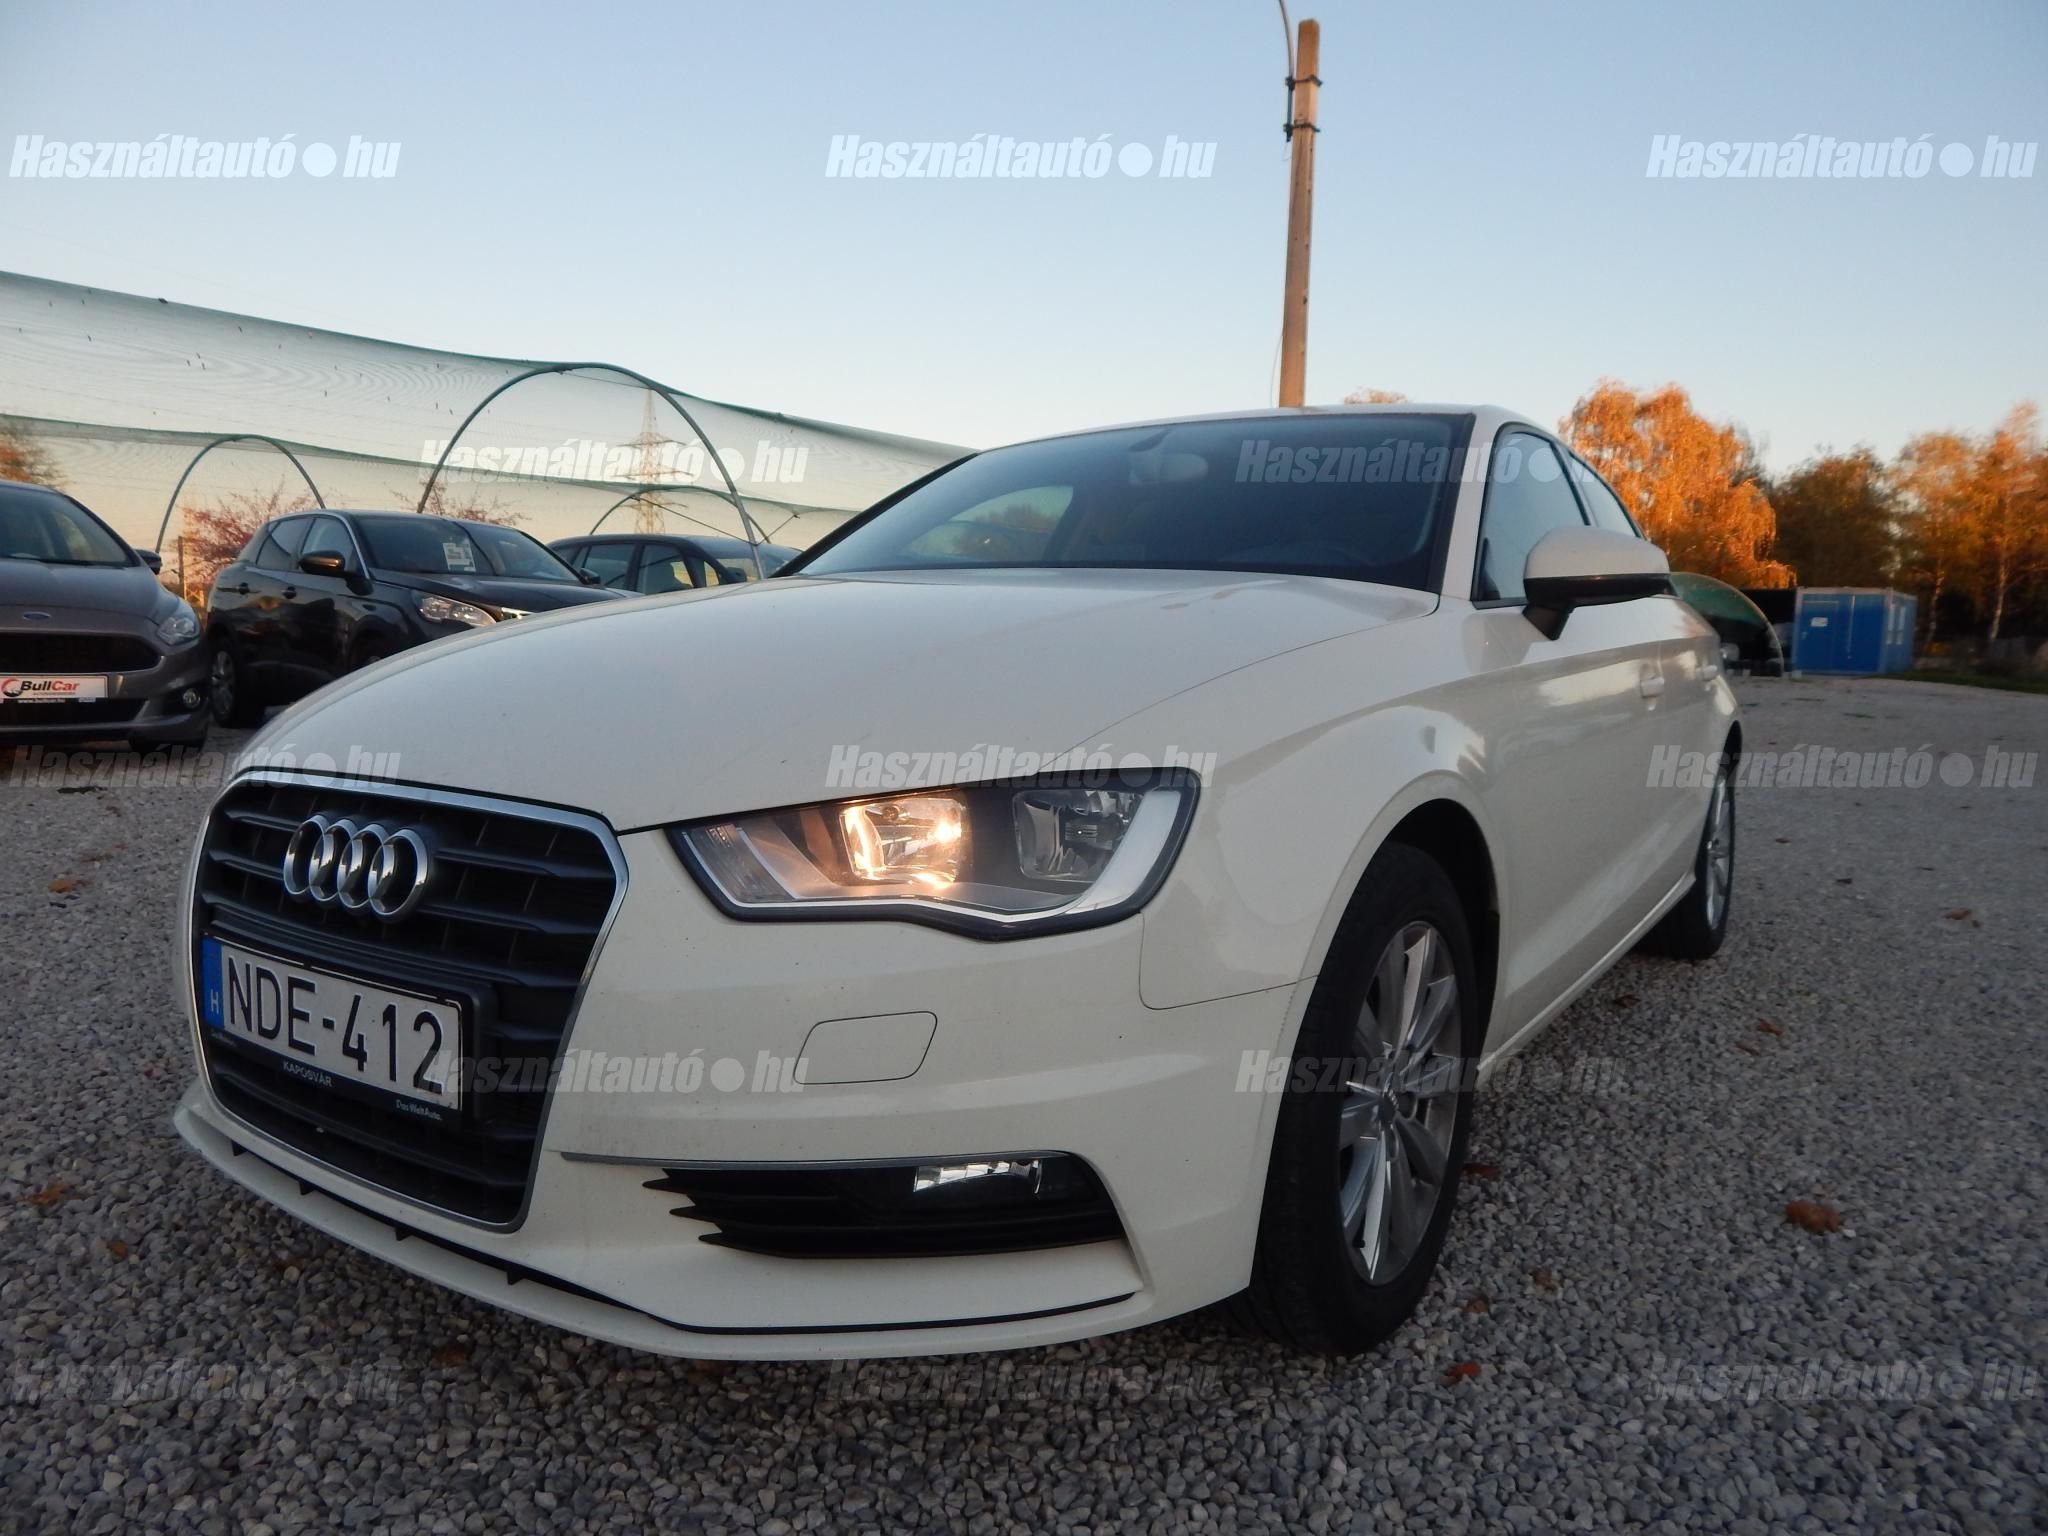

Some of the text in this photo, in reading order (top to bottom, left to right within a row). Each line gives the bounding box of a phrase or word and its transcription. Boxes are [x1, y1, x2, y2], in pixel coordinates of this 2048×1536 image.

[20, 680, 80, 692] BullCar
[209, 990, 220, 1015] H
[228, 956, 443, 1095] NDE-412
